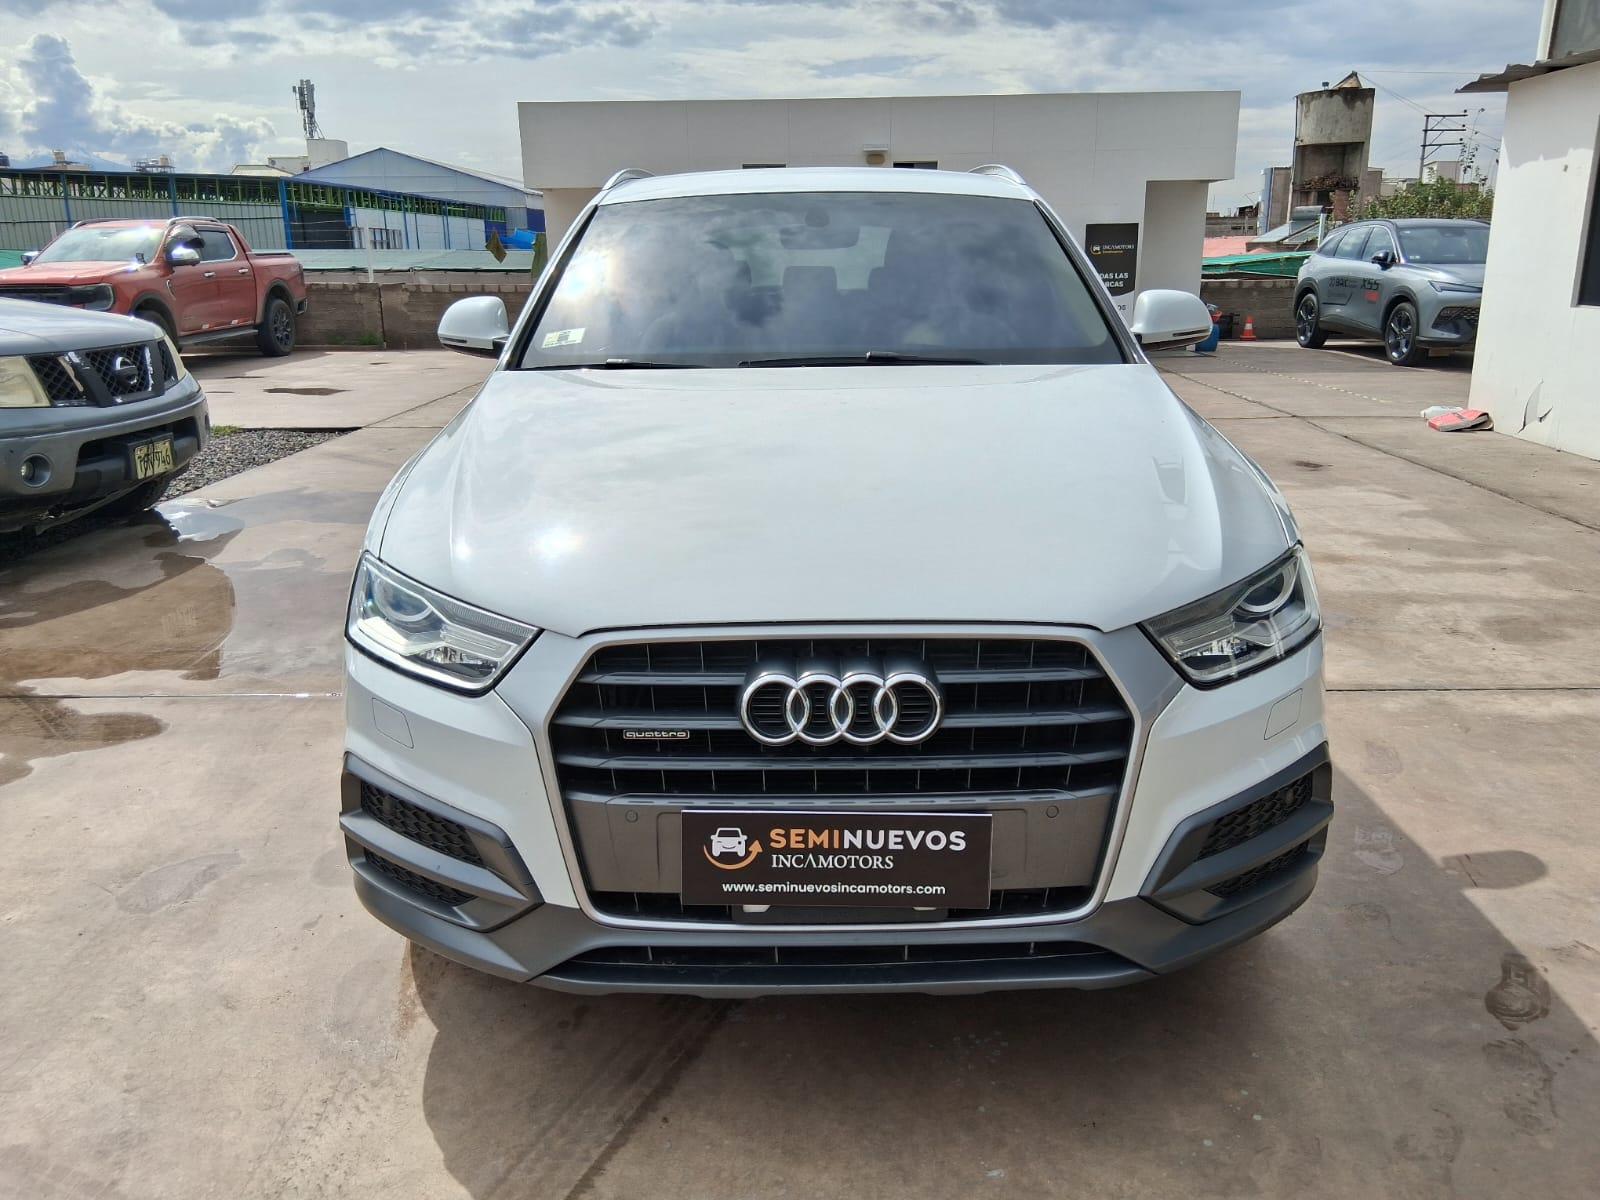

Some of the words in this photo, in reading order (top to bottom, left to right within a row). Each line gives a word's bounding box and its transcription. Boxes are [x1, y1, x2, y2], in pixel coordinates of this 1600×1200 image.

[625, 730, 687, 738] quattro
[768, 828, 967, 851] SEMINUEVOS
[771, 853, 894, 870] INCAMOTORS
[721, 881, 946, 896] www.seminuevosincamotors.com
